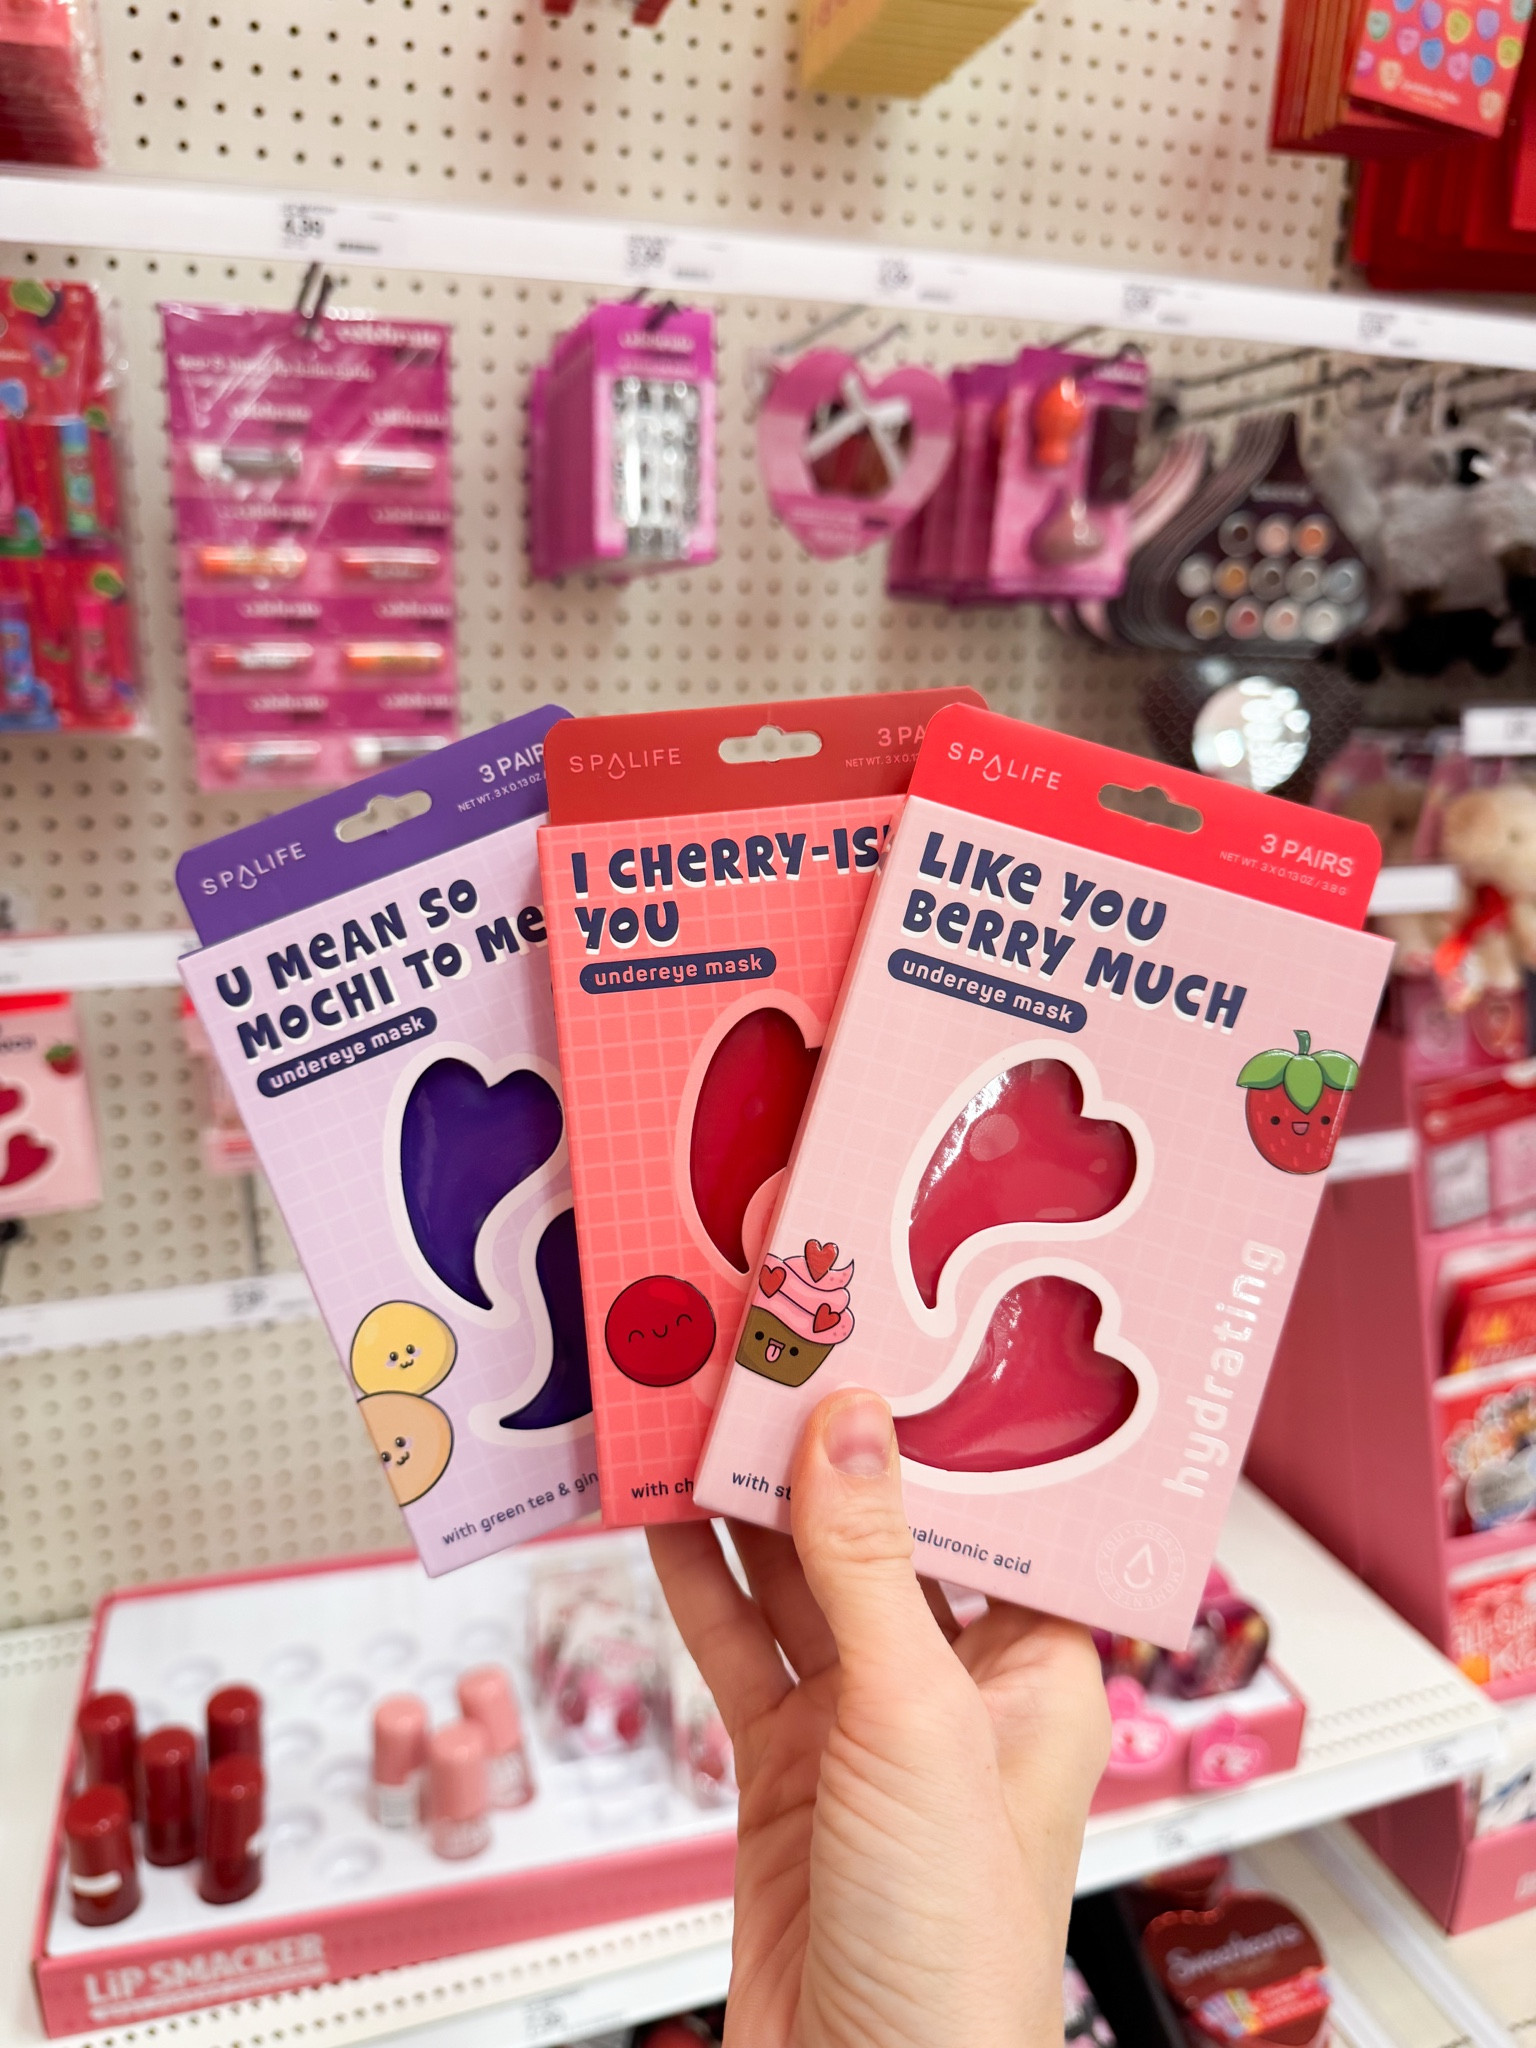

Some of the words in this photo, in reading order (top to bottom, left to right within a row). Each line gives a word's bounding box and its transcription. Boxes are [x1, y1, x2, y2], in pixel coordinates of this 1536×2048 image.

[878, 727, 892, 746] 3
[479, 764, 495, 783] 3
[496, 743, 544, 777] PAIR
[569, 748, 681, 780] SPALIFE
[846, 758, 863, 768] NET
[866, 756, 883, 766] WT.
[886, 756, 891, 764] 3
[948, 742, 1062, 790] SPALIFE
[457, 800, 477, 812] NET
[494, 789, 501, 798] 3
[509, 778, 529, 792] 0.13
[201, 842, 306, 895] SPALIFE
[572, 852, 588, 898] I
[1219, 851, 1240, 862] NET
[1260, 861, 1268, 872] 3
[1260, 834, 1277, 854] 3
[1281, 839, 1354, 877] PAIRS
[574, 901, 680, 954] YOU
[1060, 871, 1166, 945] YOU
[216, 966, 253, 1010] U
[419, 879, 478, 931] SO
[594, 959, 698, 987] undereye
[705, 954, 763, 976] mask
[903, 959, 1007, 1004] undereye
[1012, 994, 1073, 1024] mask
[1084, 947, 1248, 1032] MUCH
[237, 966, 397, 1062] MOCHI
[403, 943, 463, 990] TO
[269, 1039, 367, 1090] undereye
[370, 1015, 426, 1049] mask
[1161, 1240, 1286, 1498] hydrating
[631, 1480, 669, 1499] with
[732, 1472, 769, 1493] with
[442, 1522, 477, 1545] with
[480, 1503, 525, 1532] green
[528, 1490, 555, 1508] tea
[558, 1482, 570, 1496] &
[993, 1553, 1032, 1575] acid
[149, 1933, 324, 1989] SMACKER
